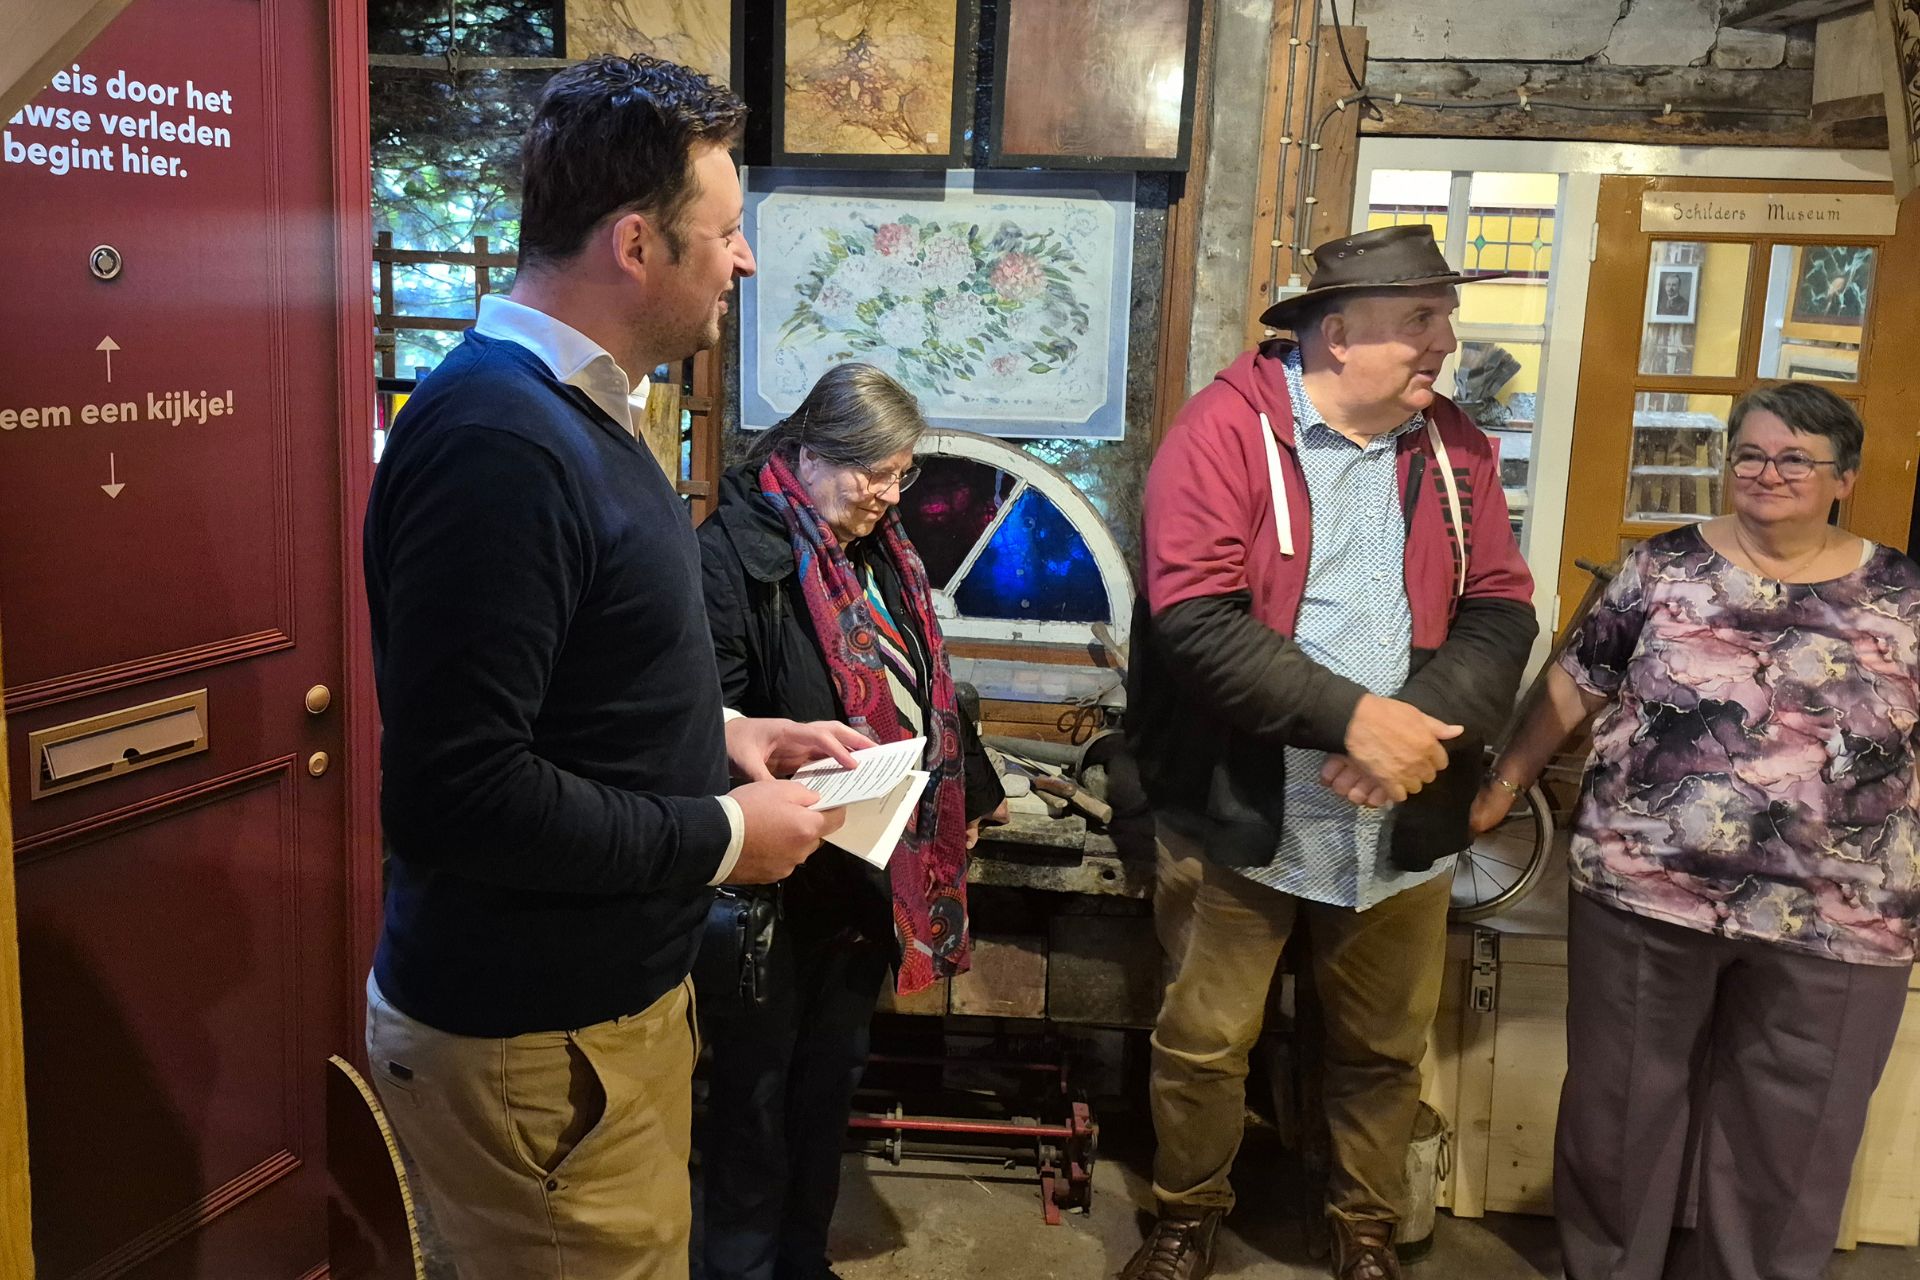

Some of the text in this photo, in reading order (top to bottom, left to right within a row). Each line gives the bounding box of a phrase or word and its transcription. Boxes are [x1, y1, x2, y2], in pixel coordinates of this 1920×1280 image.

[43, 63, 233, 115] eis door het
[99, 110, 231, 148] verleden
[3, 130, 188, 178] begint hier.
[1672, 202, 1841, 222] Schilders Museum
[80, 401, 138, 425] een
[147, 389, 234, 427] kijkje!
